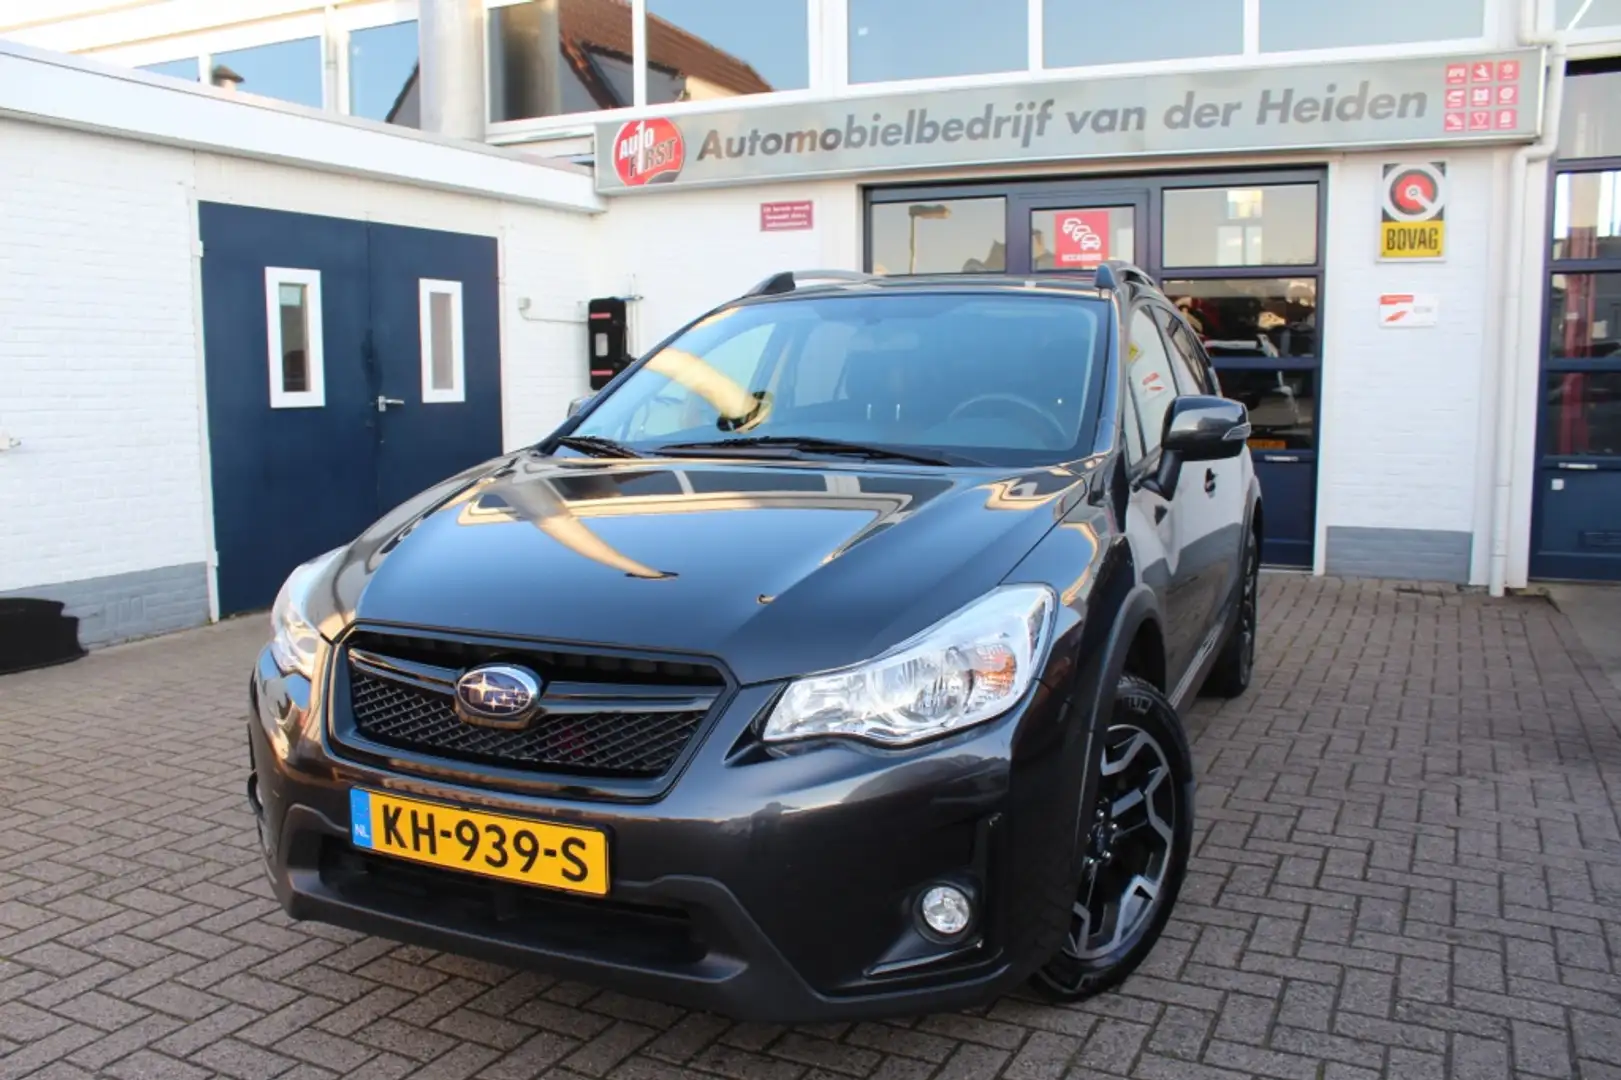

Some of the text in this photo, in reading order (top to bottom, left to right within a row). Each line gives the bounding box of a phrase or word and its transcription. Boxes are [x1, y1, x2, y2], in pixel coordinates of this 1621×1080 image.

[696, 80, 1428, 162] Automobielbedrijf van der Heiden
[1386, 227, 1438, 251] BOVAG
[354, 823, 371, 839] NL
[382, 803, 589, 883] KH-939-S
